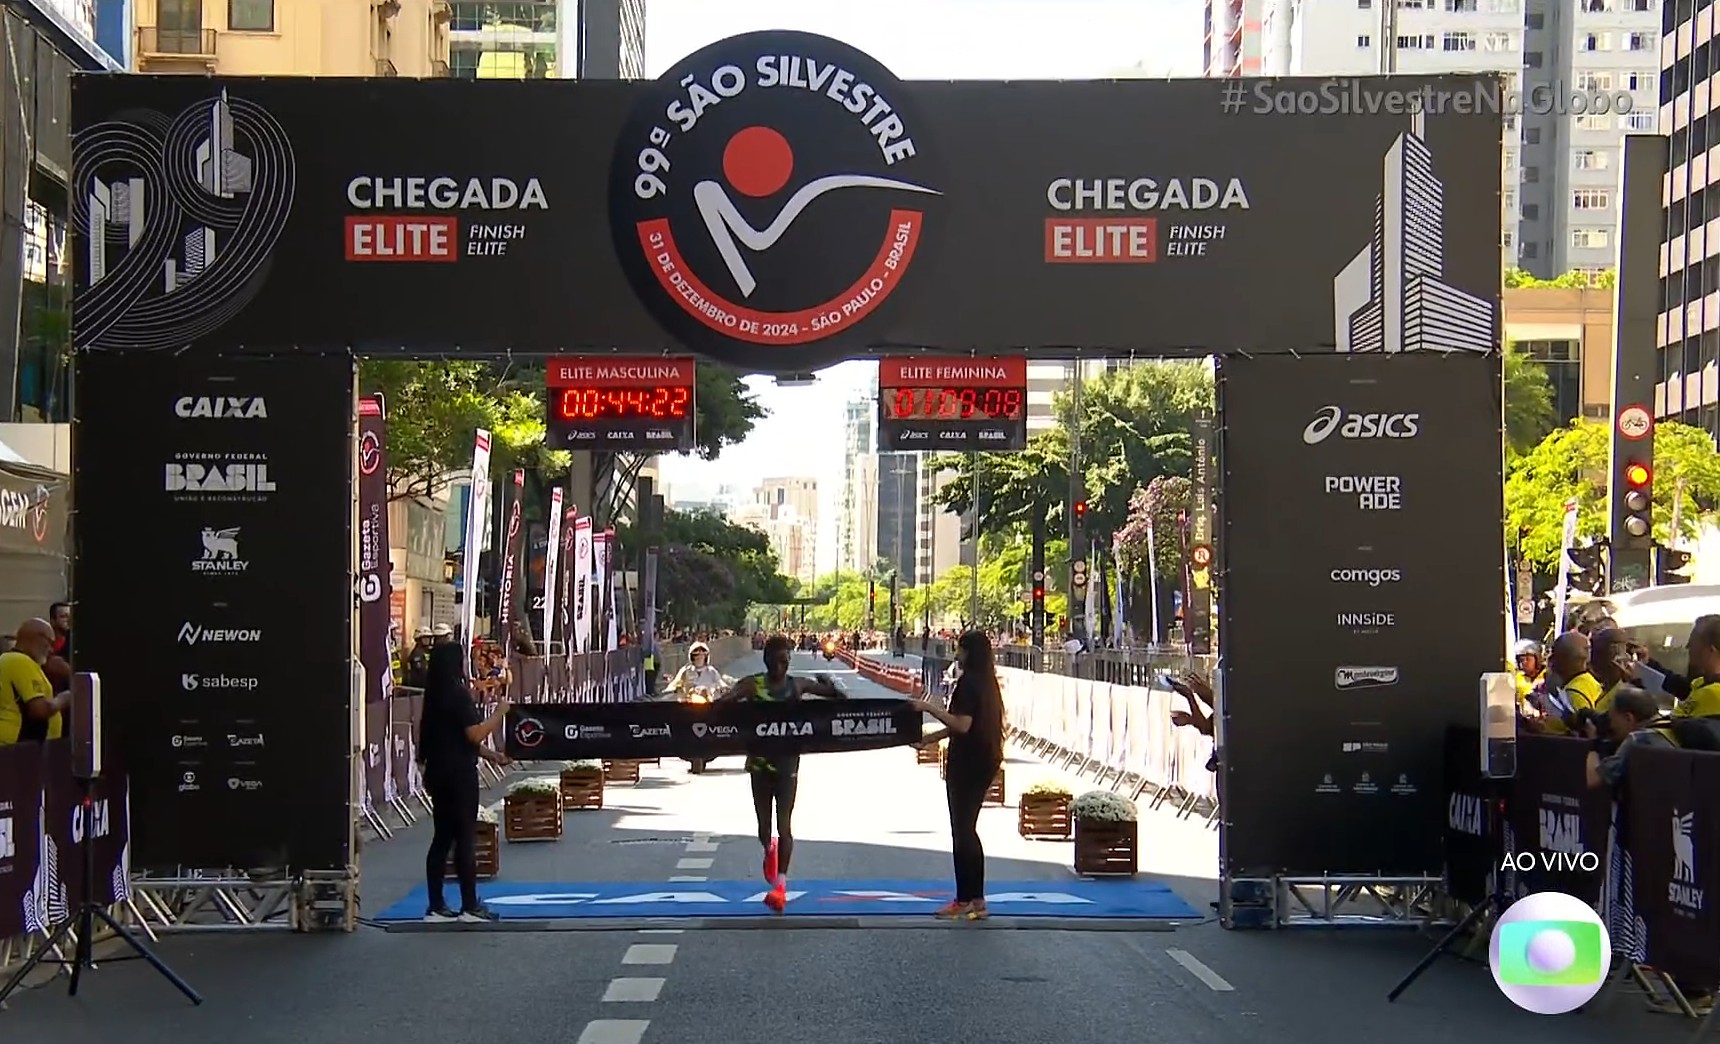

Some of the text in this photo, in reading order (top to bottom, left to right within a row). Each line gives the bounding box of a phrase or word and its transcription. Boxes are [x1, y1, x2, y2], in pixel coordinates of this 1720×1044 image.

[667, 64, 746, 132] SÃO
[757, 55, 916, 165] SILVESTRE
[347, 176, 549, 209] CHEGADA
[1047, 178, 1250, 210] CHEGADA
[353, 224, 448, 255] ELITE
[469, 224, 526, 239] FINISH
[1169, 225, 1226, 239] FINISH
[467, 242, 508, 255] ELITE
[1053, 226, 1148, 257] ELITE
[1167, 242, 1208, 256] ELITE
[649, 231, 664, 250] 31
[657, 252, 674, 274] DE
[670, 271, 737, 328] DEZEMBRO
[739, 320, 758, 335] DE
[762, 323, 798, 336] 2024
[811, 311, 841, 332] SÃO
[842, 277, 884, 317] PAULO
[885, 221, 912, 270] BRASIL
[560, 366, 680, 379] ELITE MASCULINA
[900, 367, 1007, 379] ELITE FEMININA
[175, 396, 268, 418] CAIXA
[563, 389, 687, 417] 00:44:22
[1341, 413, 1419, 438] asics
[175, 452, 221, 460] GOVERNO
[165, 463, 276, 491] BRASIL
[1325, 476, 1400, 493] POWER
[1359, 493, 1401, 510] ADE
[361, 519, 371, 571] Gazeta
[192, 561, 250, 571] STANLEY
[201, 629, 262, 641] NEWON
[202, 674, 259, 690] sabesp
[709, 725, 739, 733] VEGA
[756, 722, 814, 737] CAIXA
[831, 718, 898, 736] BRASIL
[1539, 808, 1585, 854] BRASIL
[1668, 882, 1704, 910] STANLEY
